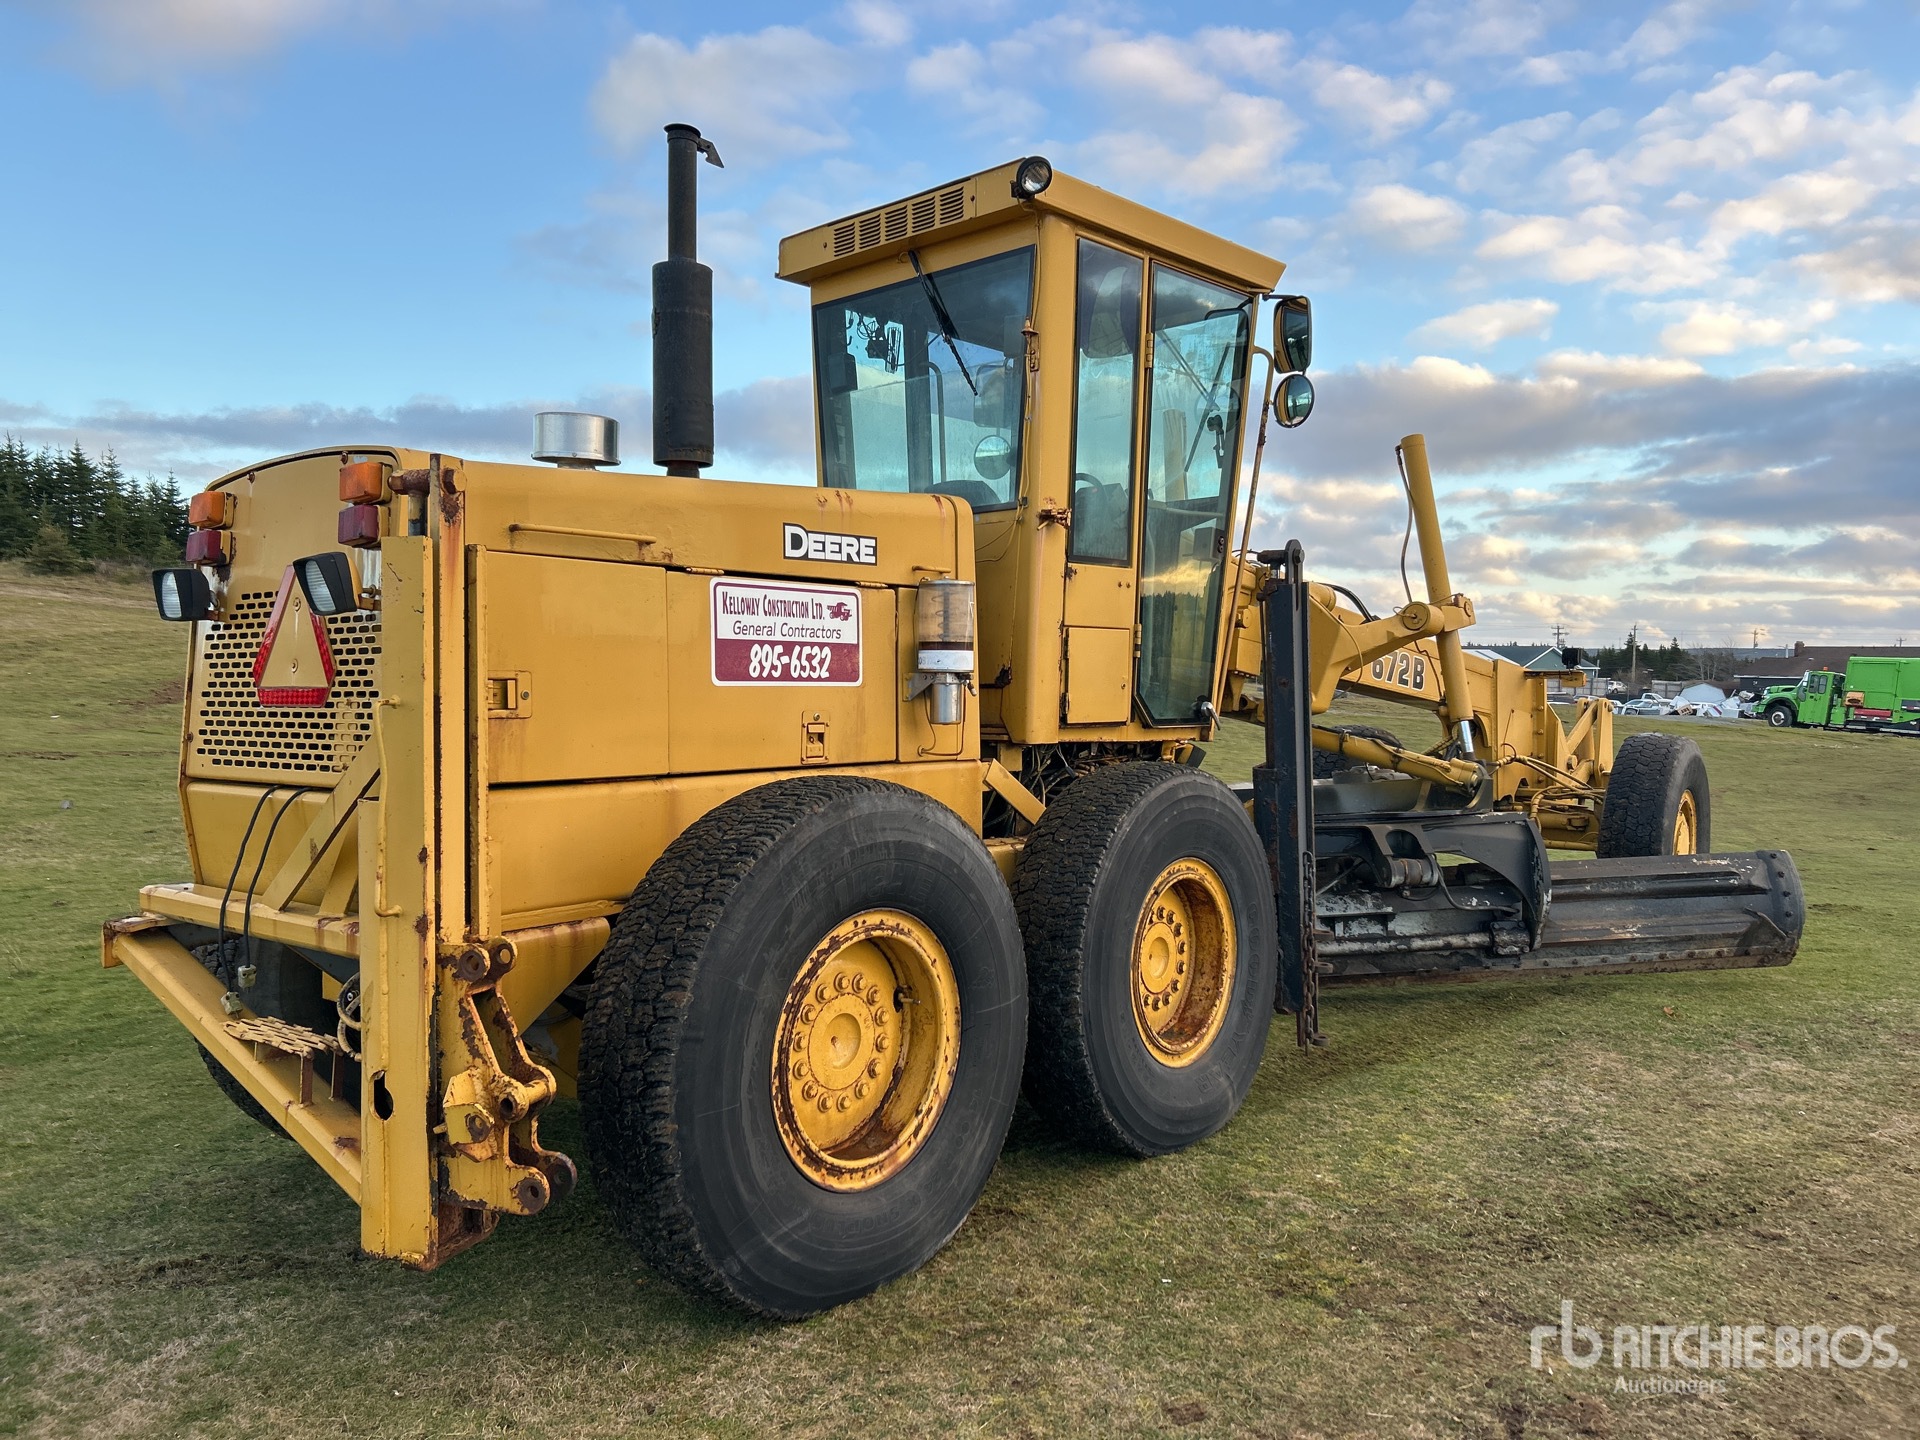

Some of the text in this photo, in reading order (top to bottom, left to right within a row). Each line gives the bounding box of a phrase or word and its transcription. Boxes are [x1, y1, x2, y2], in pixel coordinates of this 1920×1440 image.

[785, 525, 876, 564] DEERE
[733, 620, 841, 639] General Contractors
[749, 643, 831, 678] 895-6532
[1372, 650, 1424, 691] 672B
